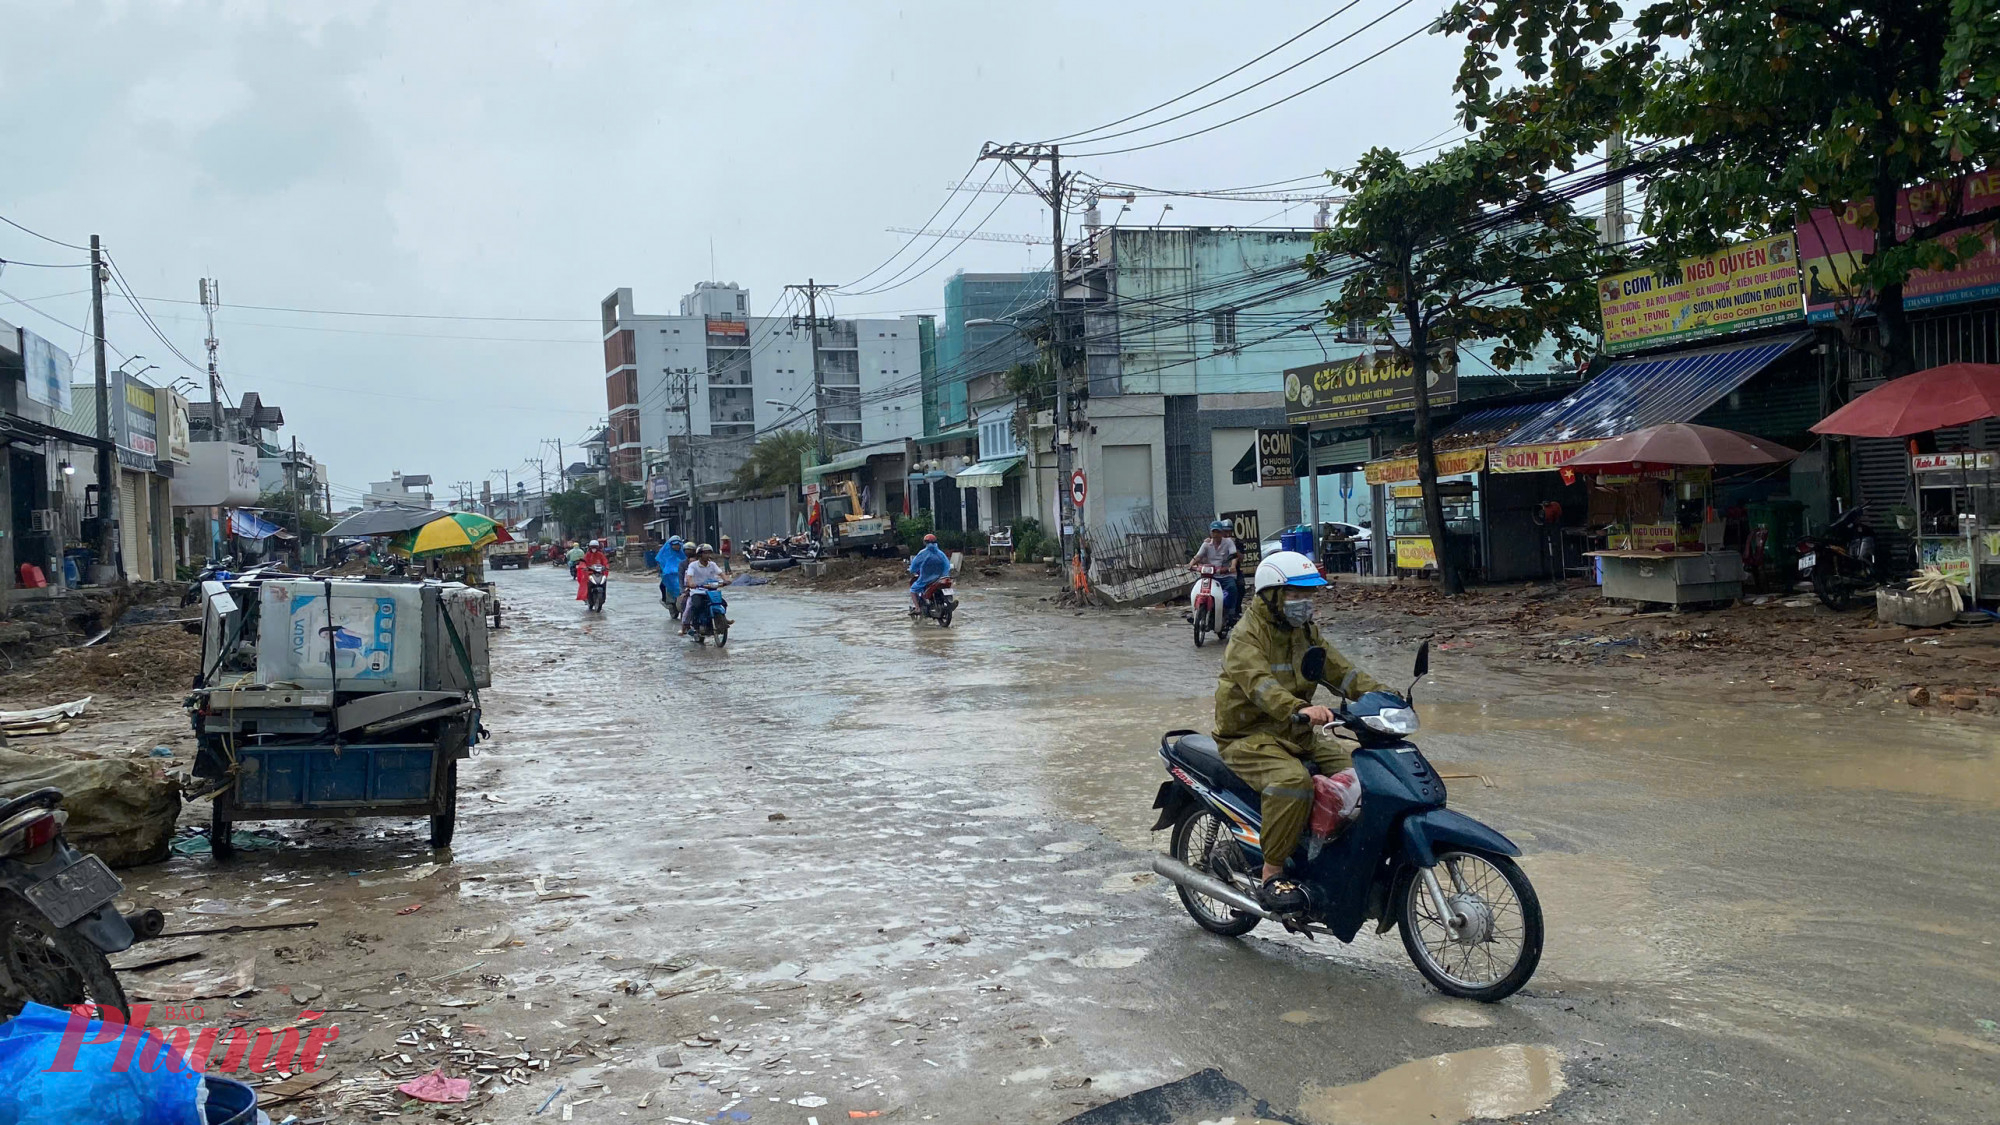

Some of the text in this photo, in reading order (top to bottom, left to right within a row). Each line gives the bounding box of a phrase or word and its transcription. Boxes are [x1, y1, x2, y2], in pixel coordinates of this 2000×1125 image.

[1623, 275, 1651, 296] CƠM
[1687, 257, 1715, 283] NGÔ
[1719, 243, 1767, 277] QUYỀN
[1755, 272, 1768, 285] QUE
[1771, 266, 1797, 281] NƯỚNG
[1693, 298, 1714, 314] SƯỜN
[1734, 289, 1762, 306] NƯỚNG
[1763, 282, 1785, 300] MUỐI
[1787, 281, 1798, 297] ỚT
[1713, 311, 1734, 321] Giao
[1736, 306, 1758, 317] Cơm
[1261, 431, 1291, 455] CƠM
[1276, 466, 1293, 475] 35K
[1506, 451, 1539, 468] CƠM
[1232, 513, 1257, 539] ƠM
[292, 618, 305, 656] AQUA
